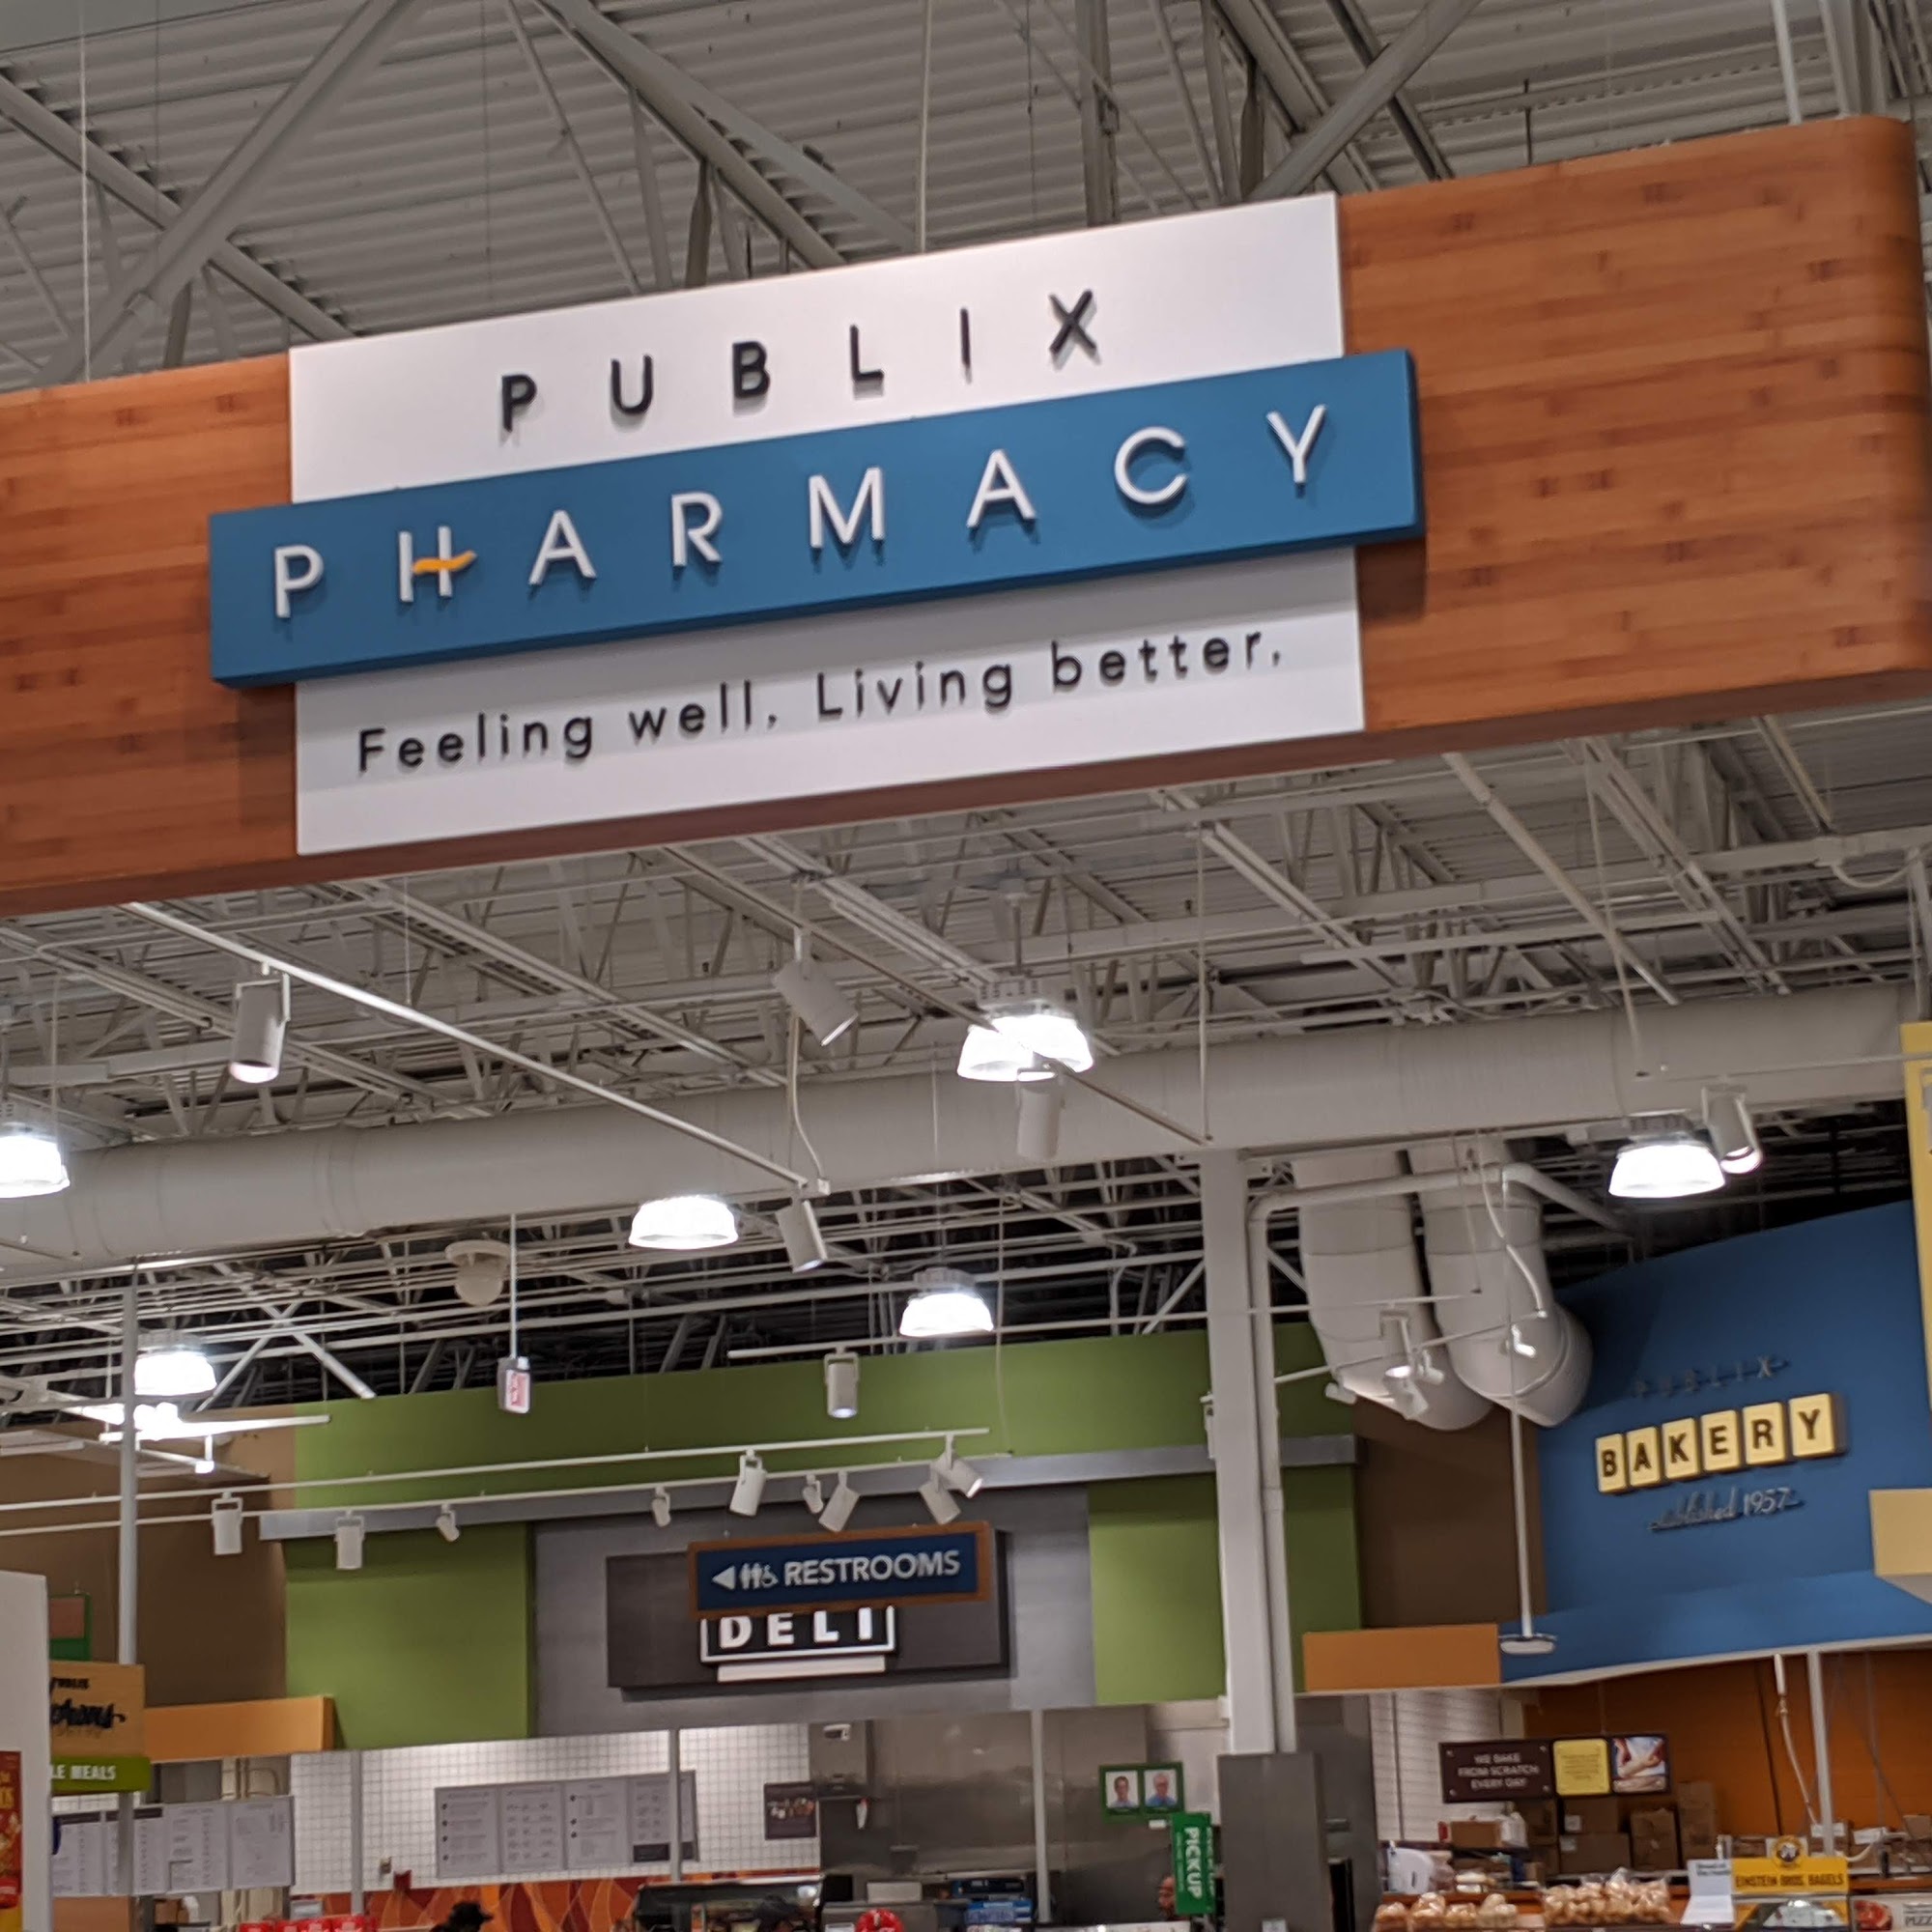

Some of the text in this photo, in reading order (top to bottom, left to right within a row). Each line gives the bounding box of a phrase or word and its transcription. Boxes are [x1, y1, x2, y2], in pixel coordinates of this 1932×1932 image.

[500, 290, 1097, 433] PUBLIX
[273, 404, 1327, 618] PHARMACY
[358, 713, 593, 773] Feeling
[817, 662, 1012, 716] Living
[1601, 1407, 1821, 1478] BAKERY
[783, 1548, 961, 1587] RESTROOMS
[719, 1605, 873, 1650] DELI
[1184, 1827, 1203, 1899] PICKUP
